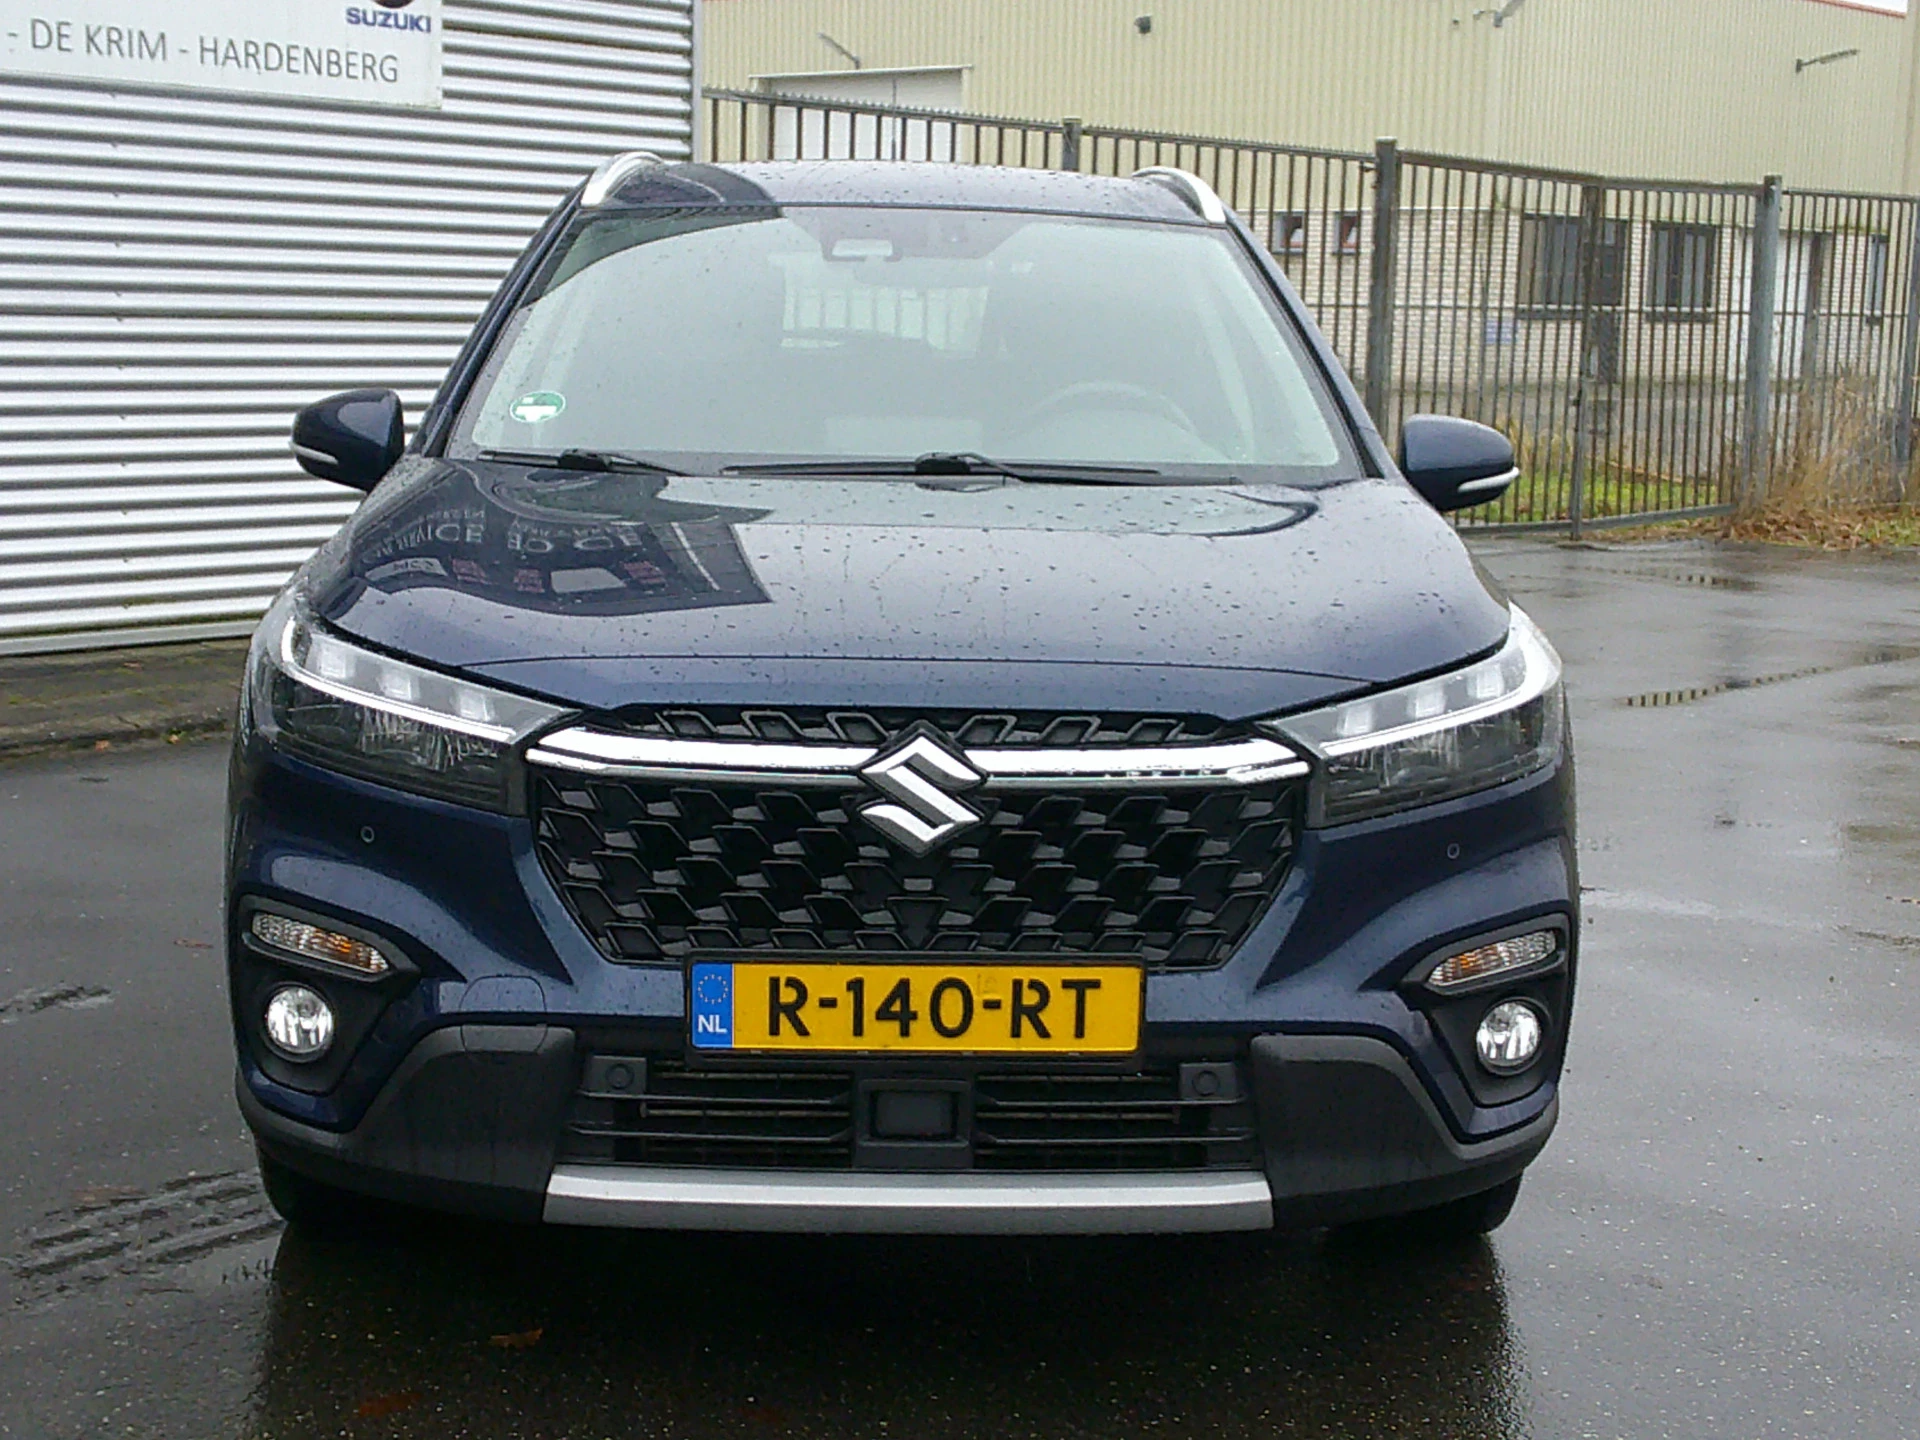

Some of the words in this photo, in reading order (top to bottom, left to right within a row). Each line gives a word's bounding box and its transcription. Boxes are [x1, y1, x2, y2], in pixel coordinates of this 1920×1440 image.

[346, 7, 431, 33] SUZUKI
[30, 18, 72, 52] DE
[85, 24, 167, 61] KRIM
[199, 35, 398, 83] HARDENBERG
[698, 1015, 727, 1033] NL
[768, 976, 1102, 1039] R-140-RT
